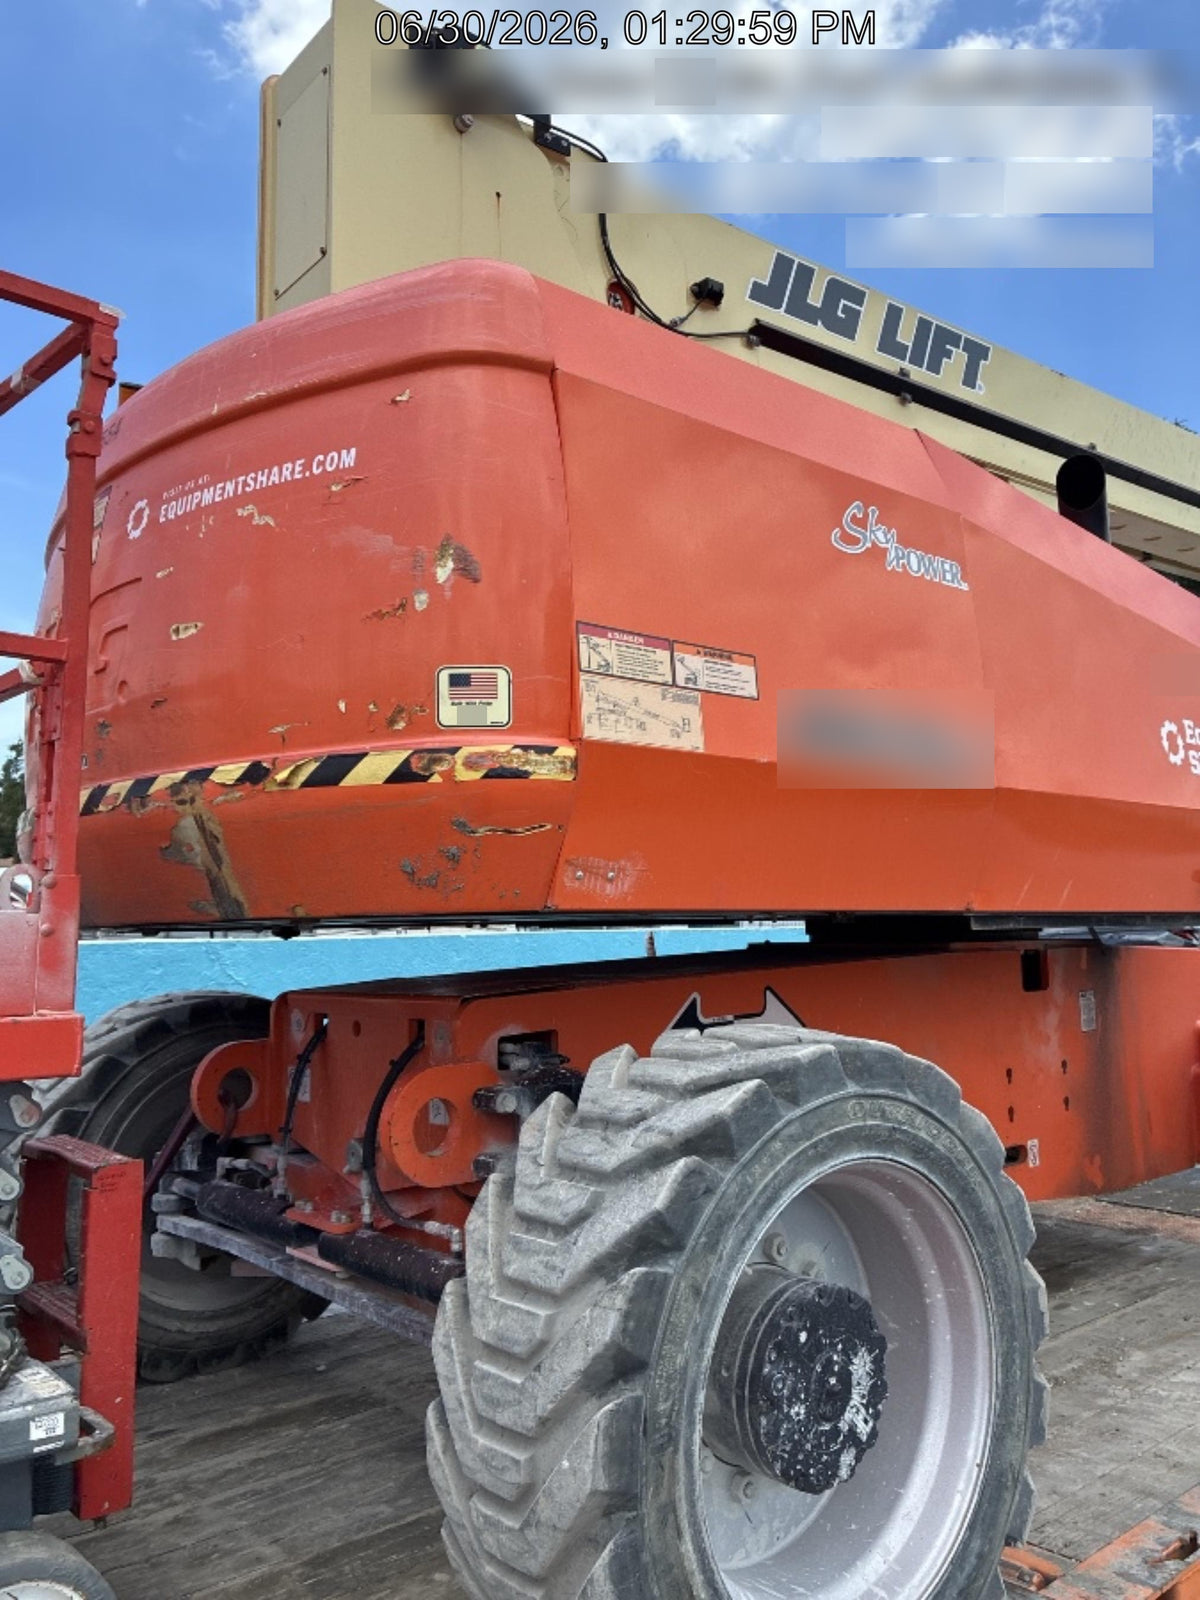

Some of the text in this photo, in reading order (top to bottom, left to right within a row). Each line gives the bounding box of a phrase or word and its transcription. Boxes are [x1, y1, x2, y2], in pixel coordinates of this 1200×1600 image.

[745, 249, 993, 394] JLG LIFT
[159, 447, 357, 524] EQUIPMENTSHARE.COM
